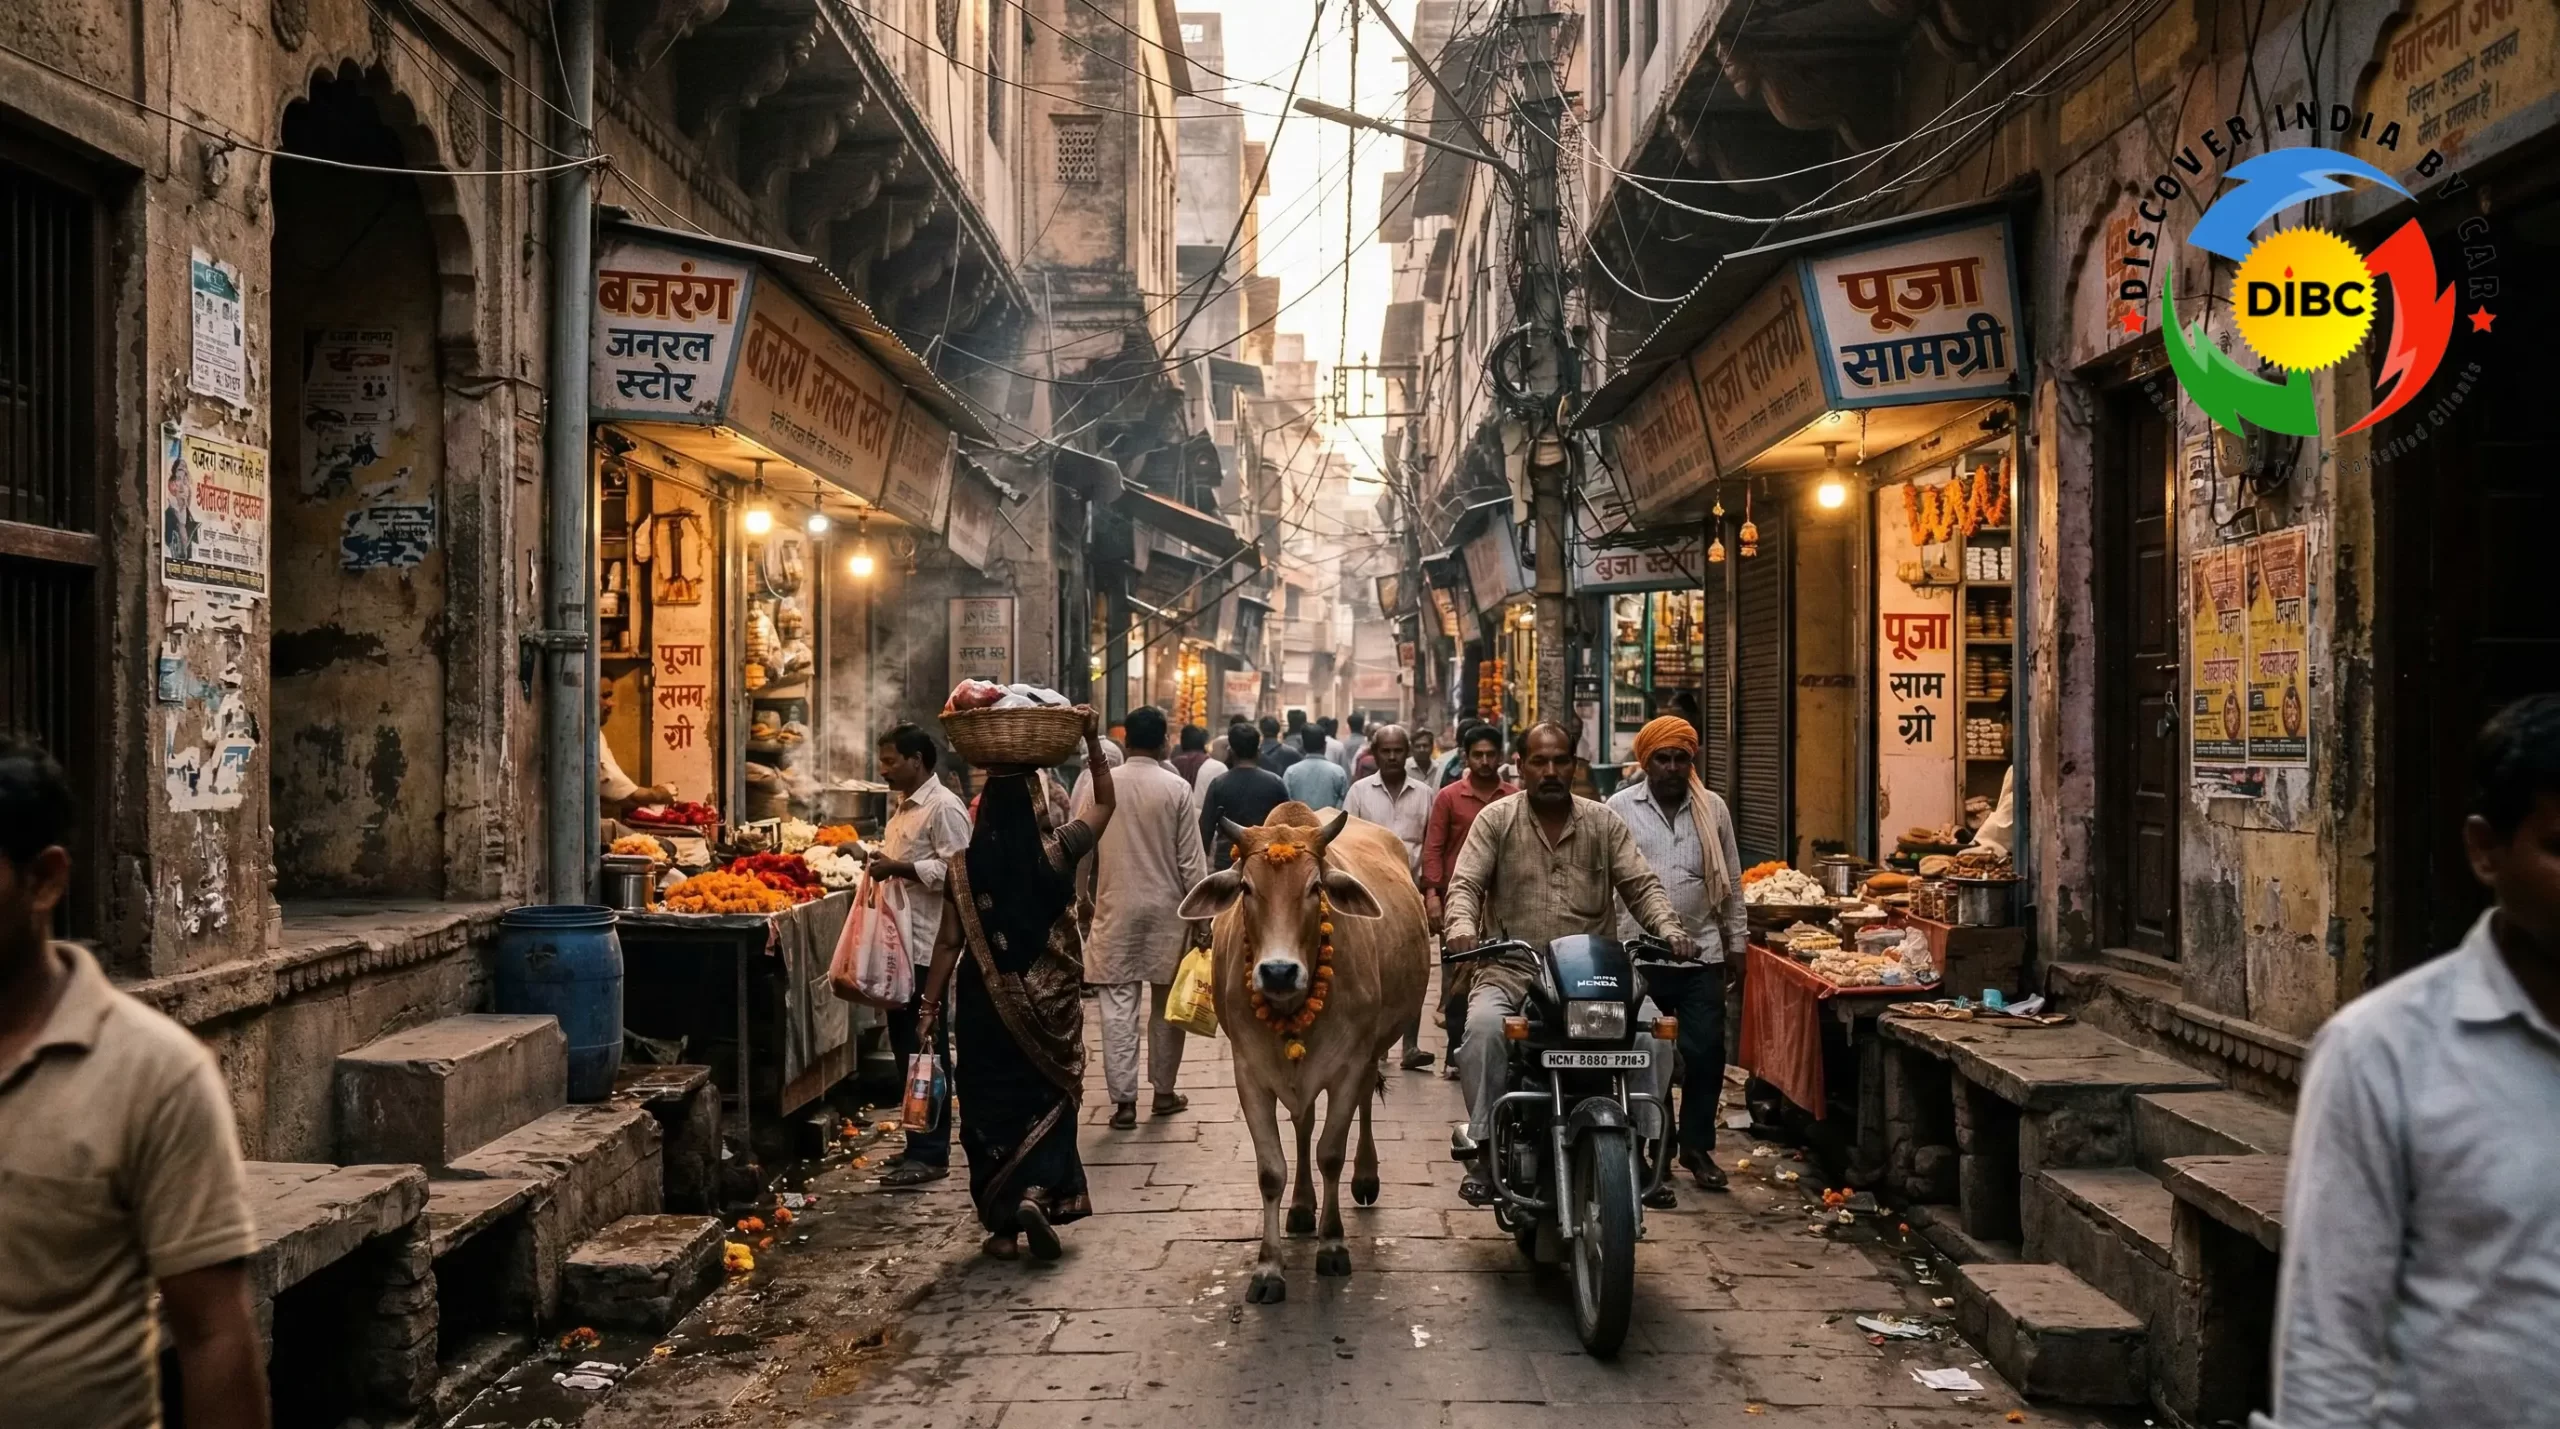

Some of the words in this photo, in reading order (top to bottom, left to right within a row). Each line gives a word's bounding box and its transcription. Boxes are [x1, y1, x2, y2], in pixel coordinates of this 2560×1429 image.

[599, 262, 736, 321] बजरंग
[1838, 257, 1981, 332] पूजा
[606, 328, 715, 362] जनरल
[747, 310, 811, 404] बजरंग
[1840, 312, 2006, 386] सामग्री
[616, 362, 697, 403] स्टोर
[658, 645, 704, 675] पूजा
[1883, 613, 1951, 661] पूजा
[1889, 673, 1946, 702] साम
